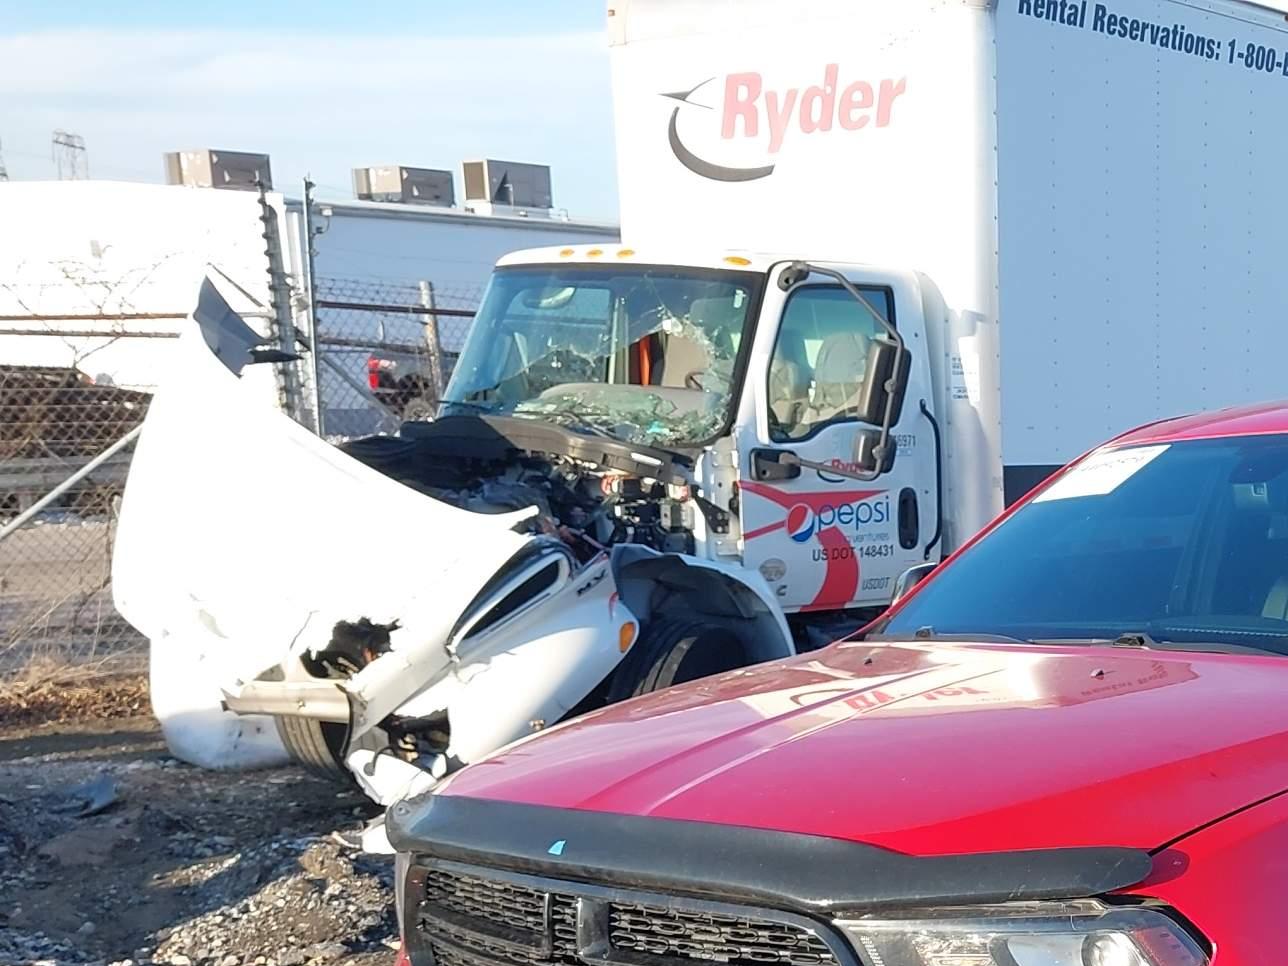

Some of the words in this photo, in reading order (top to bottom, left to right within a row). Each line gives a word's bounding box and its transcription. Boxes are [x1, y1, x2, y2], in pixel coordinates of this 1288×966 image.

[1092, 3, 1221, 61] Reservations:
[721, 63, 907, 154] Ryder
[818, 495, 890, 532] pepsi
[812, 548, 829, 562] US
[831, 546, 856, 560] DOT
[859, 544, 895, 558] 148431
[862, 577, 890, 592] USDOT
